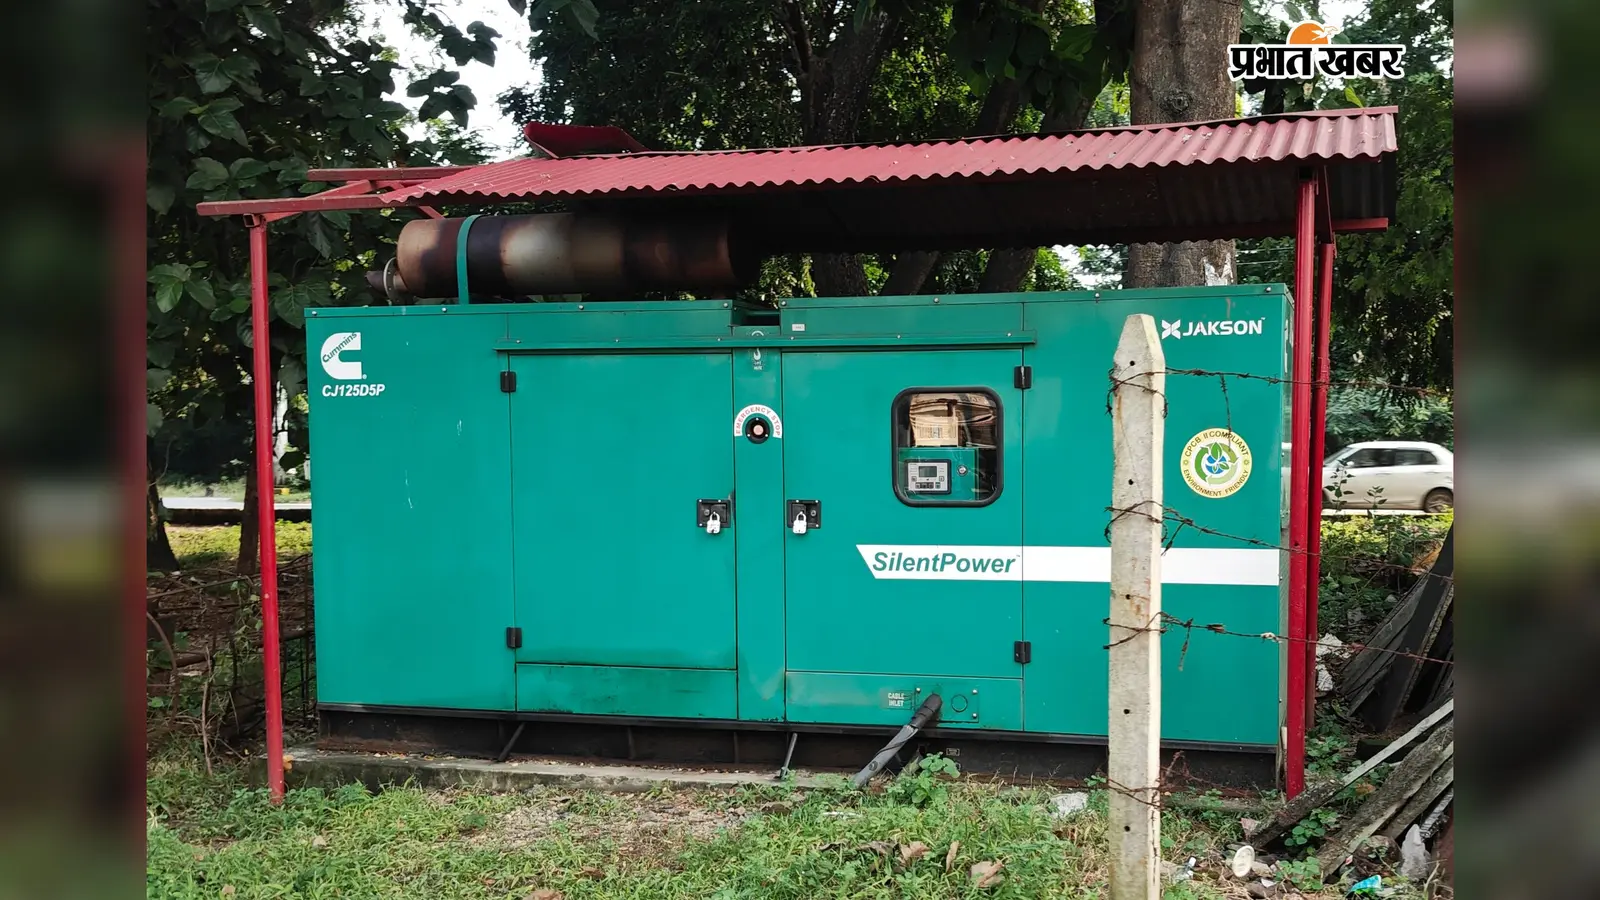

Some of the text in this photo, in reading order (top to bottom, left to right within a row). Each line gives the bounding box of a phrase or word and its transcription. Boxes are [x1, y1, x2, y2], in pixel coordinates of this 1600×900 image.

[1182, 320, 1263, 336] JAKSON
[322, 332, 358, 363] Cummins
[322, 384, 386, 397] CJ125D5P
[736, 406, 781, 436] EMERGENCY STOP
[1184, 436, 1202, 457] CPCB
[1209, 430, 1249, 456] COMPLIANT
[1183, 469, 1249, 497] ENVIRONMENT FRIENDLY
[872, 551, 1016, 573] SilentPower
